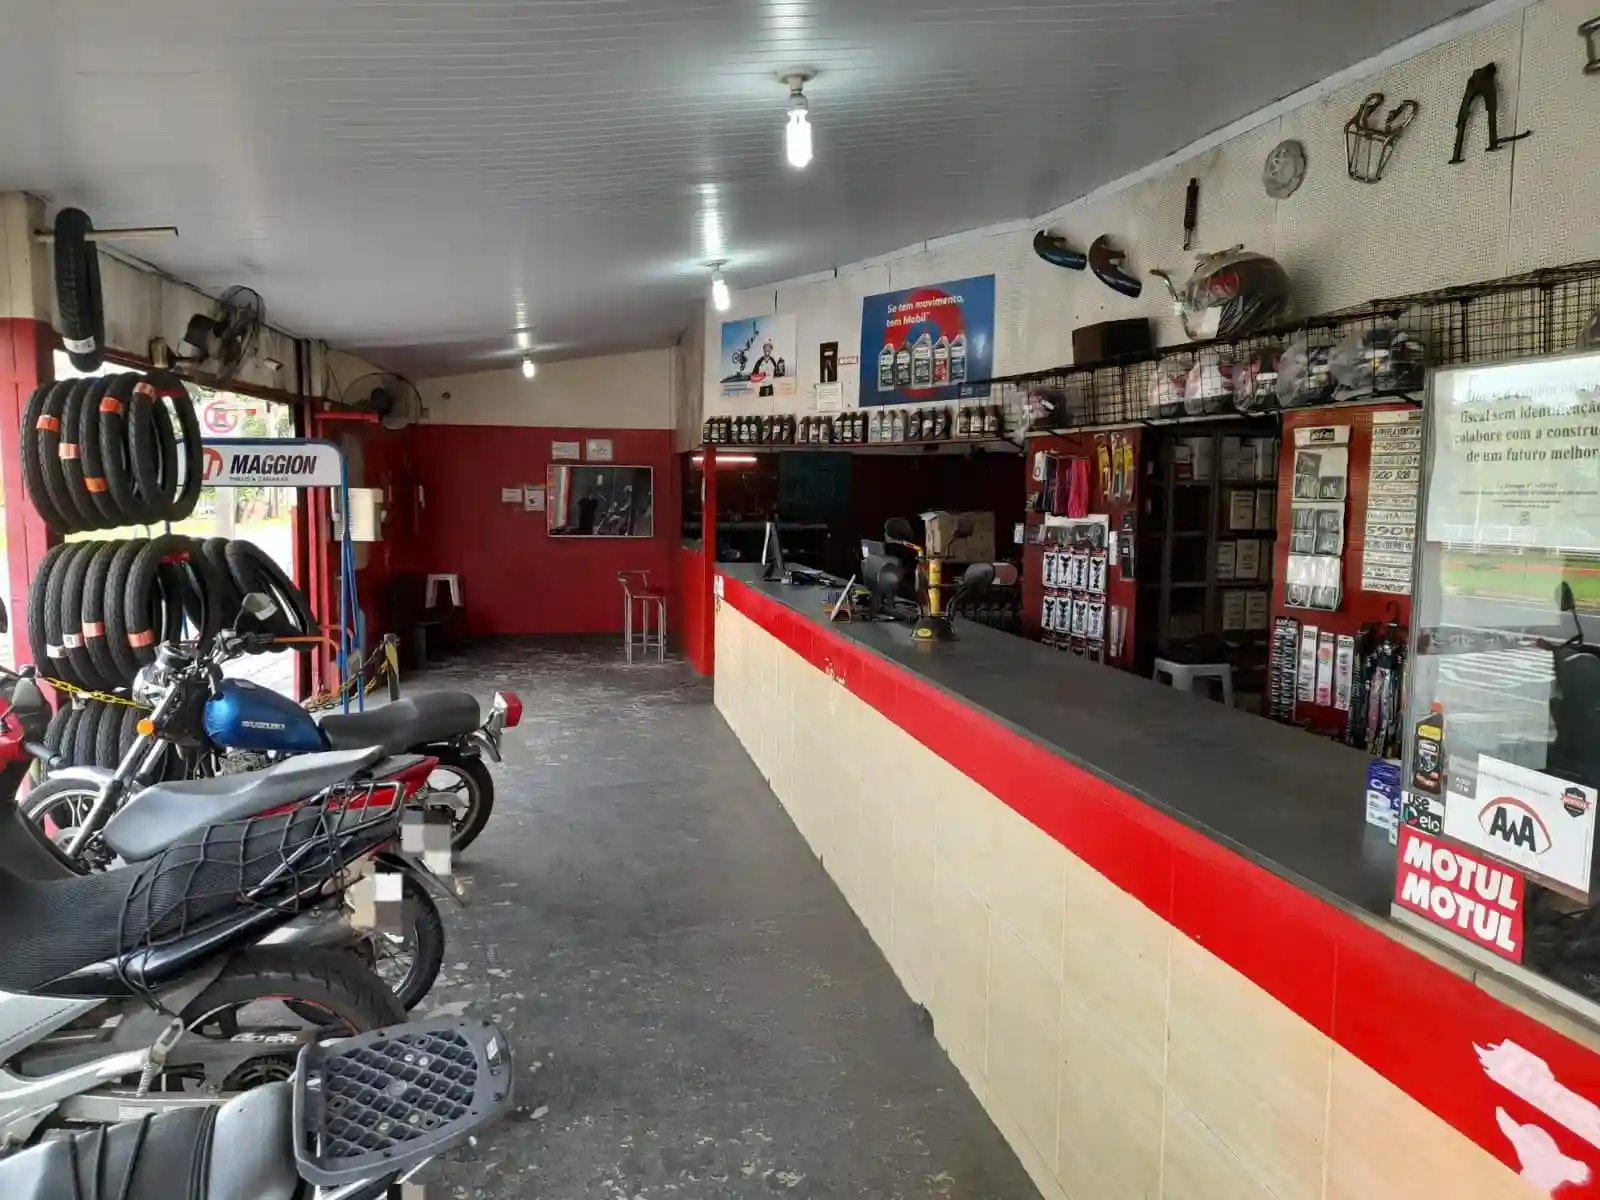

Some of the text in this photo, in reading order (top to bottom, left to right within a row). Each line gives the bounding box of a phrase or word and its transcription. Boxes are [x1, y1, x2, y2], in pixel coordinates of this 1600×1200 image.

[887, 304, 897, 314] Se
[898, 303, 913, 312] tem
[886, 319, 902, 328] tem
[1493, 410, 1516, 421] sem
[1506, 429, 1531, 441] com
[1535, 428, 1543, 439] a
[1546, 425, 1600, 438] constru
[1466, 450, 1480, 462] de
[1483, 451, 1502, 462] um
[1506, 448, 1546, 462] futuro
[230, 454, 317, 475] MAGGION
[1419, 815, 1441, 832] elo
[1403, 836, 1518, 911] MOTUL
[1401, 872, 1516, 953] MOTUL
